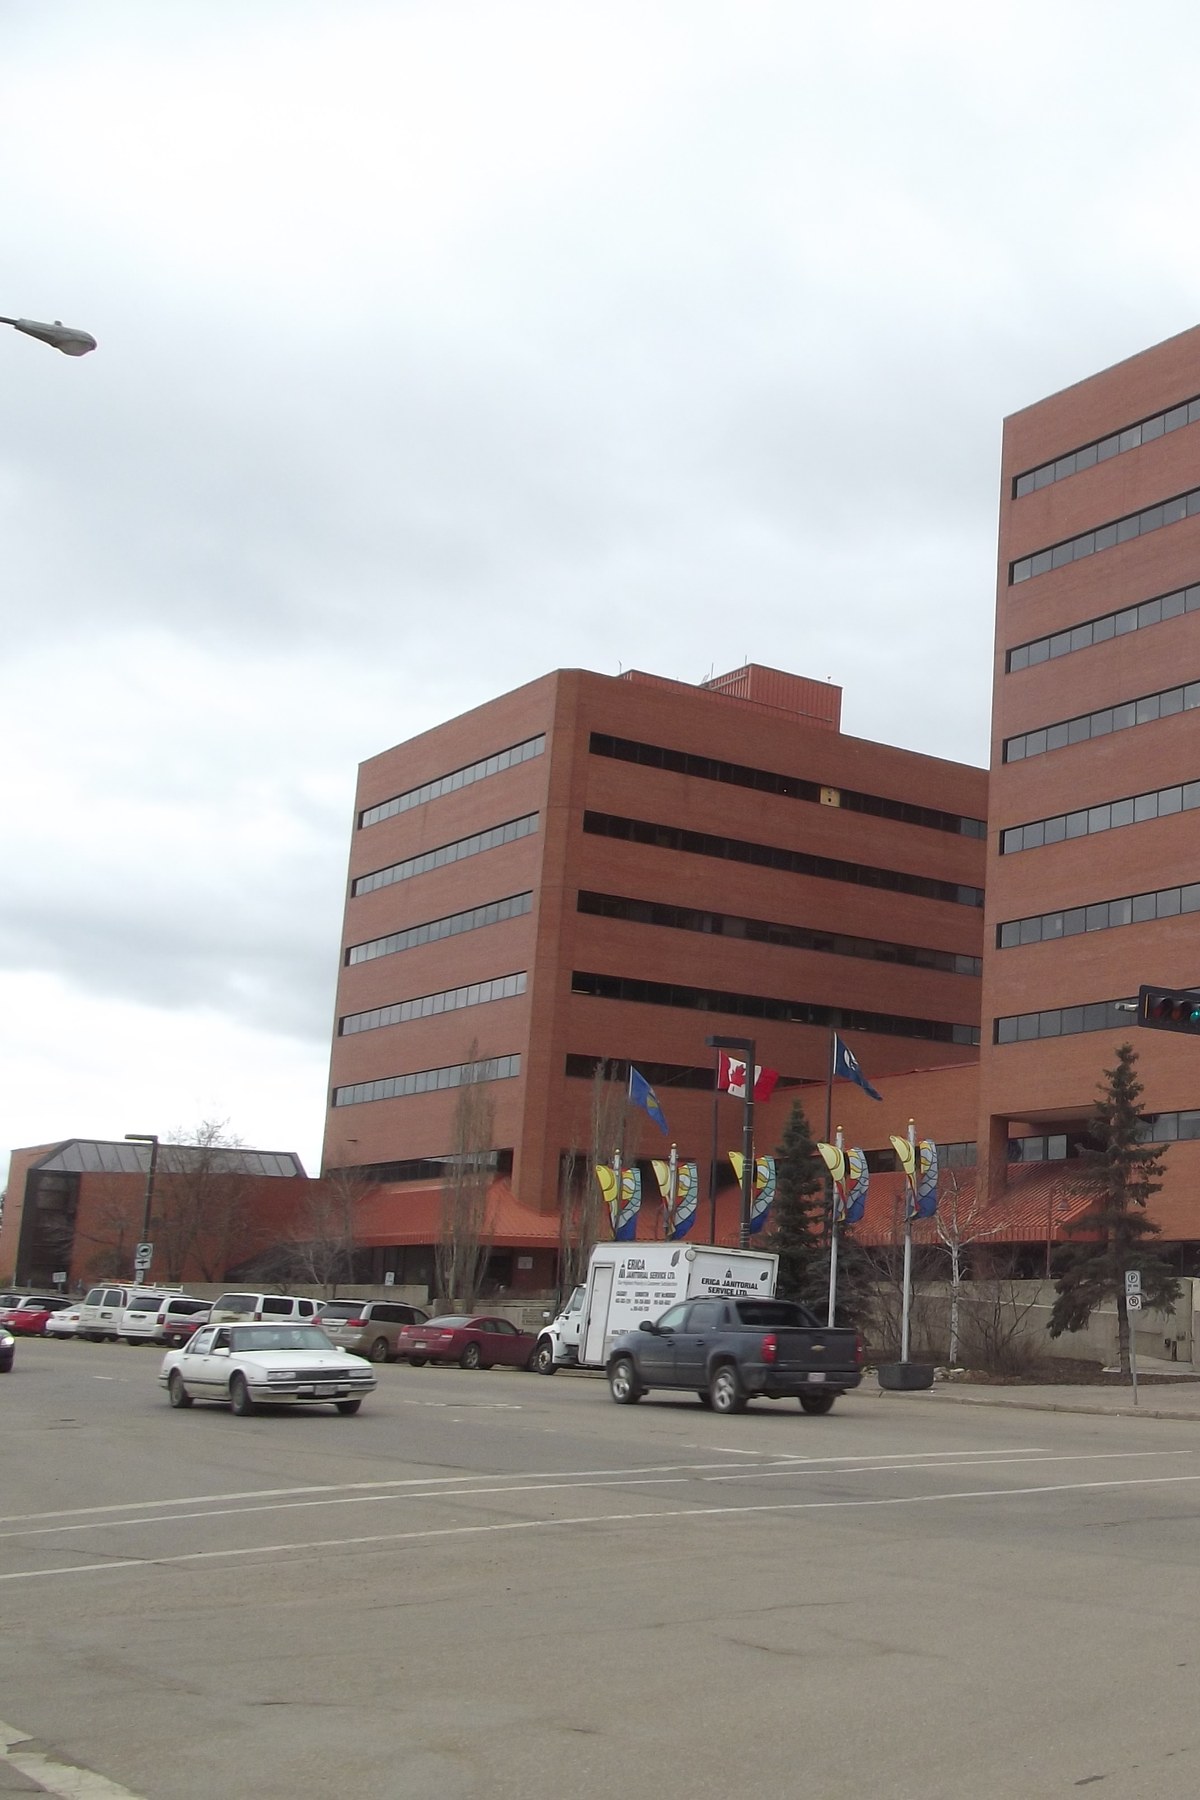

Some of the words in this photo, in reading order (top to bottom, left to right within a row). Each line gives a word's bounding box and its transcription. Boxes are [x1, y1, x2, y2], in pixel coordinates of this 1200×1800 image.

[627, 1259, 645, 1270] ERICA
[701, 1277, 720, 1286] ERICA
[722, 1279, 758, 1290] JANITORIAL
[708, 1286, 734, 1296] SERVICE
